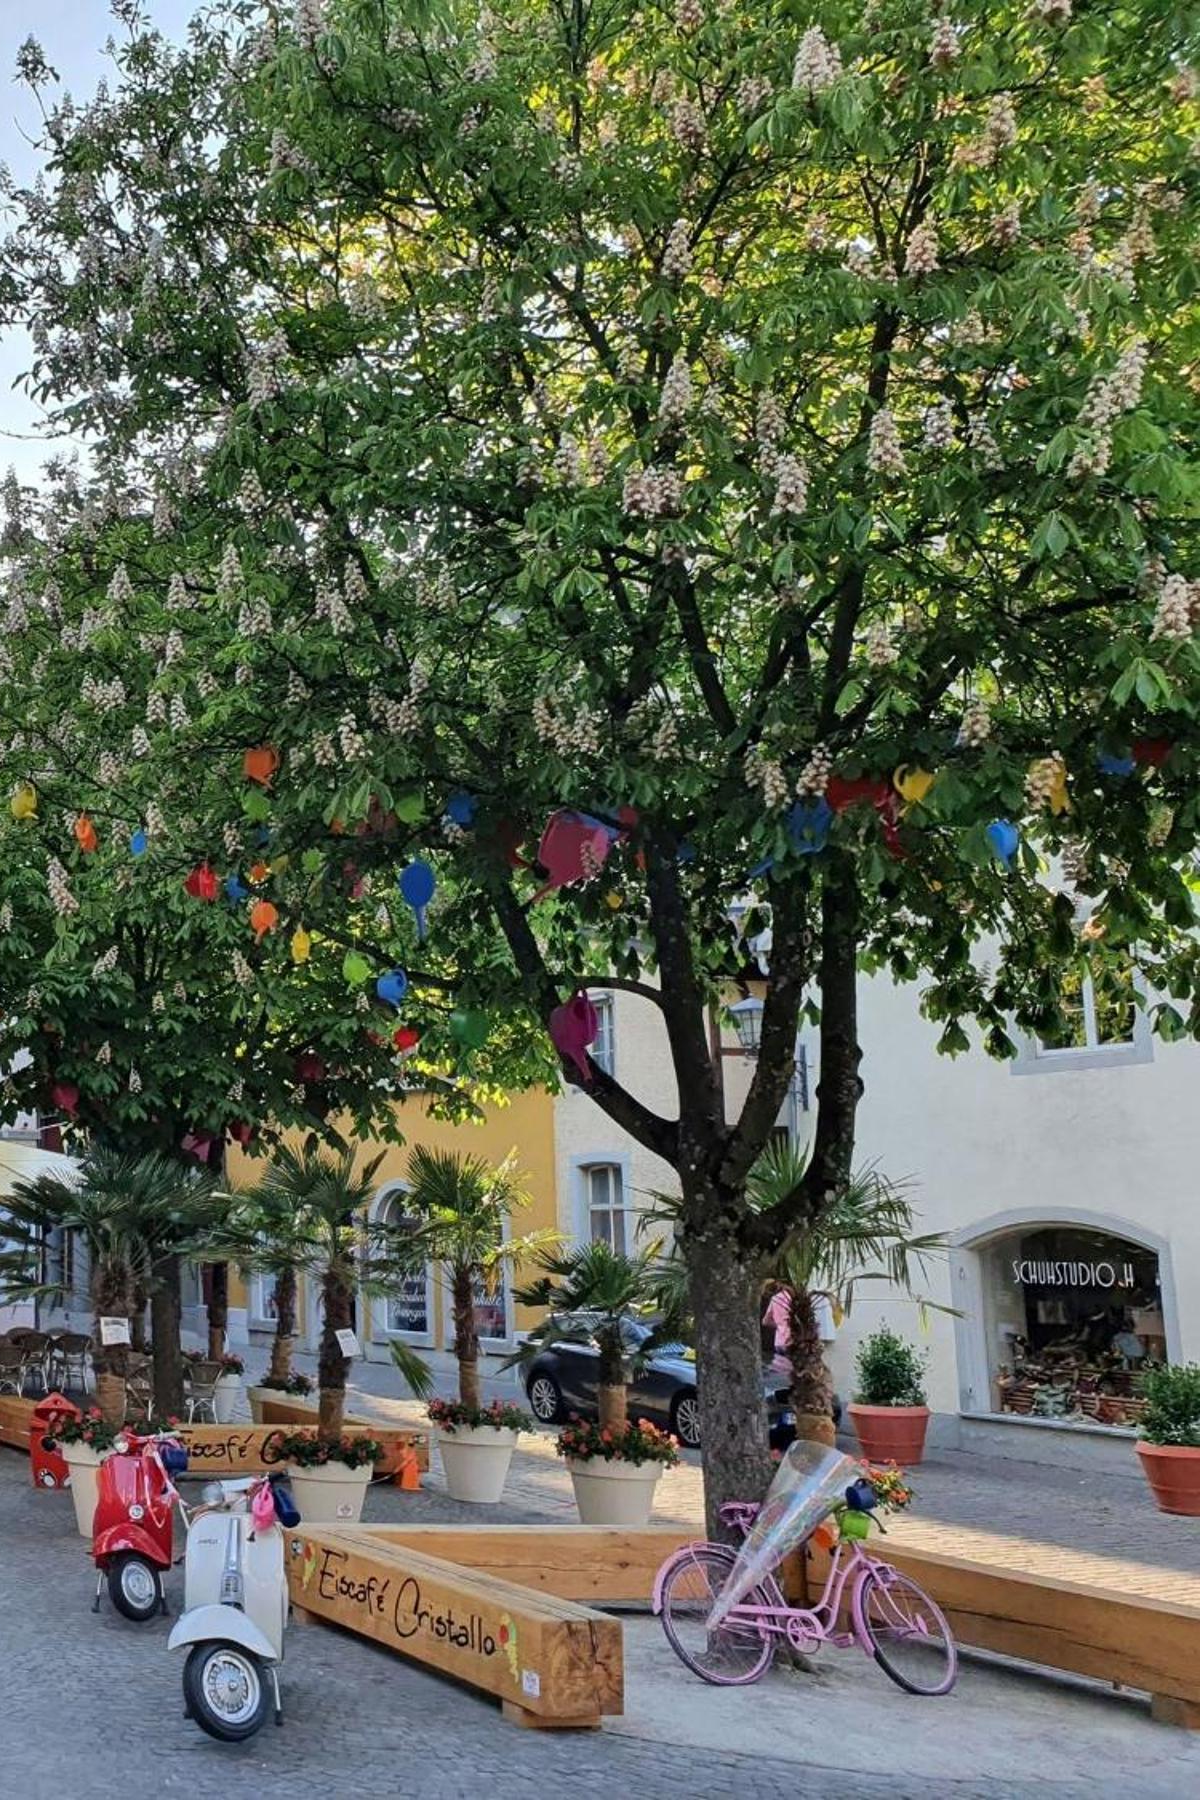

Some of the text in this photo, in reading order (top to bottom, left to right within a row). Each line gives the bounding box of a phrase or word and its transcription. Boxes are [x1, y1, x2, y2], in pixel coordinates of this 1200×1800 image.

[1012, 1260, 1115, 1287] SCHUHSTUDIO
[318, 1548, 496, 1655] Eiscafé Cristallo
